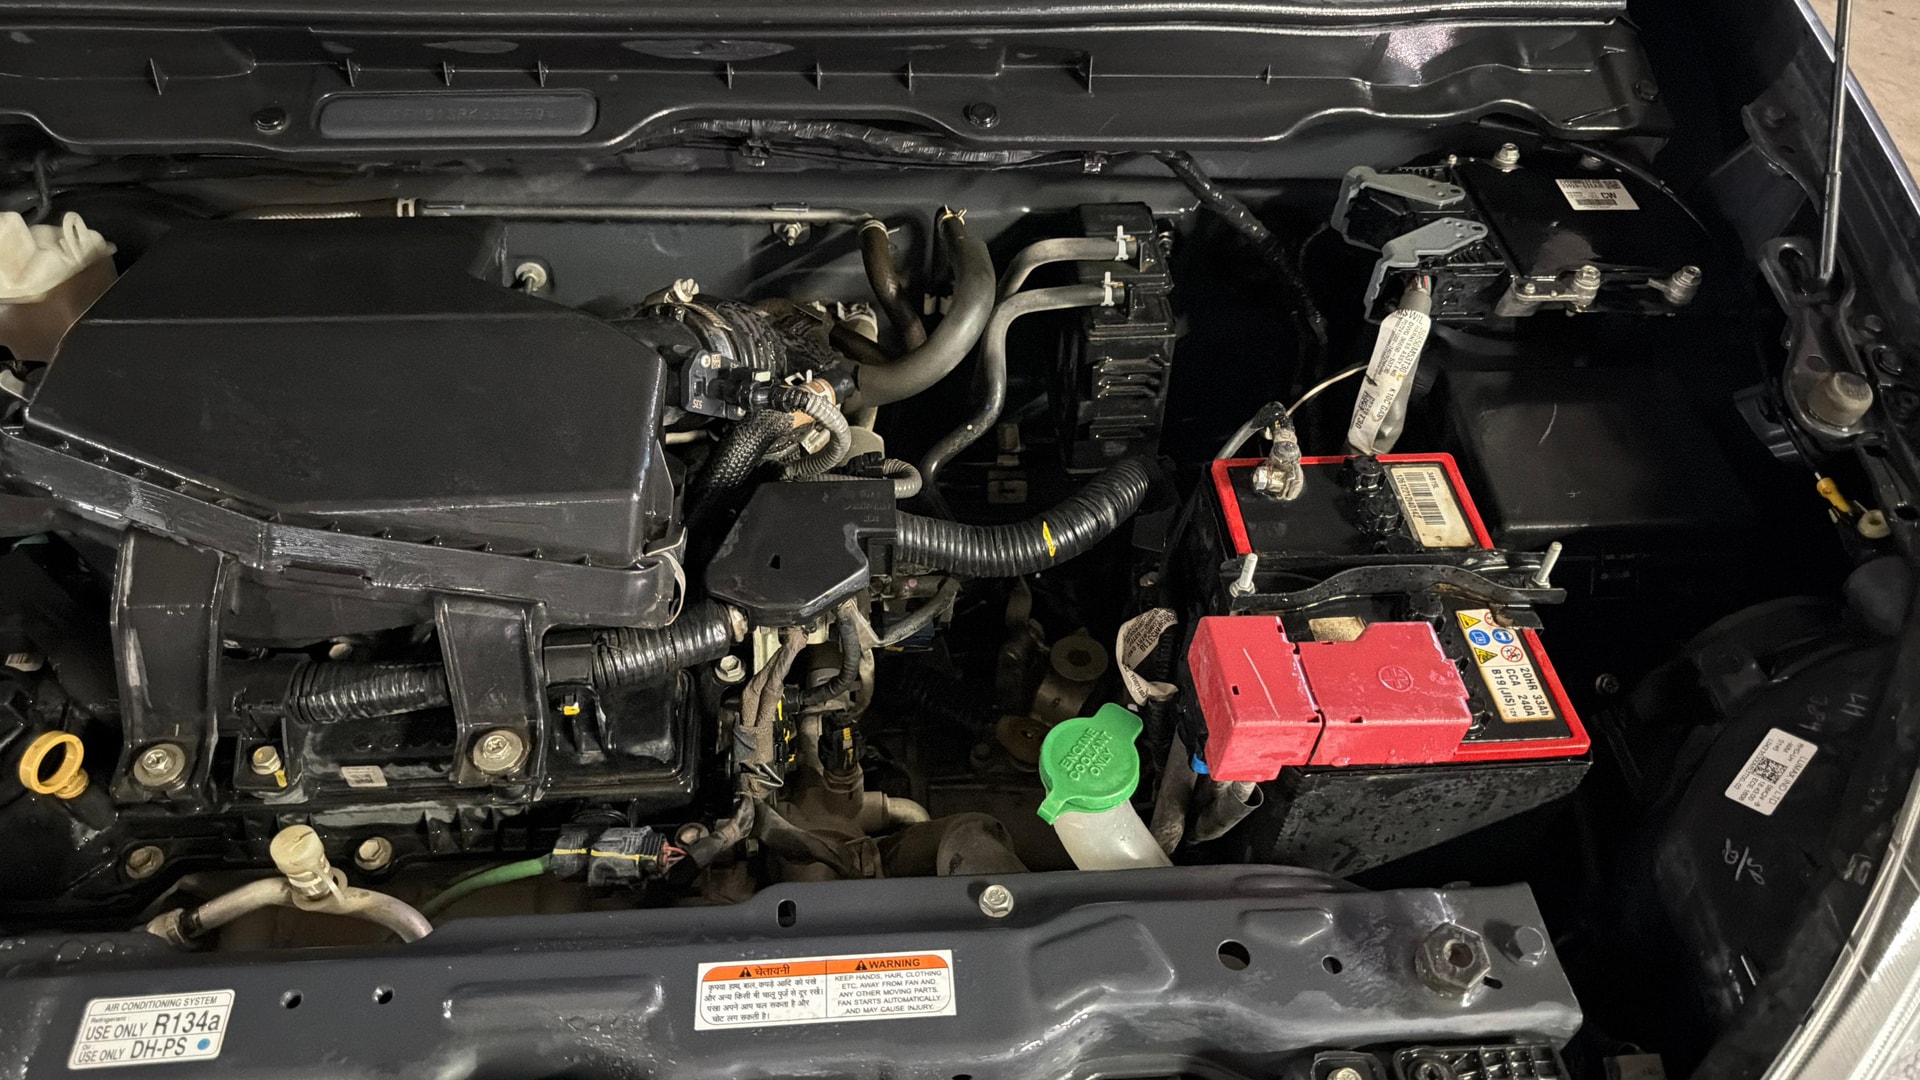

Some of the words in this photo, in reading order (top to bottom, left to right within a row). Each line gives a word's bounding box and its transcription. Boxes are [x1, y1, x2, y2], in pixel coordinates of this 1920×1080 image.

[1506, 668, 1521, 686] CCA
[1517, 694, 1536, 717] 240A
[1520, 667, 1538, 691] 20HR
[1532, 694, 1550, 717] 33Ah
[1059, 727, 1100, 772] ENGINE
[1068, 730, 1113, 781] COOLANT
[1089, 747, 1114, 777] ONLY
[1790, 755, 1808, 779] LUMAX
[869, 958, 921, 969] WARNING
[754, 964, 791, 977] चेतावनी
[884, 972, 904, 980] HAIR,
[905, 970, 942, 978] CLOTHING
[777, 978, 791, 987] आदि
[794, 977, 803, 986] को
[860, 981, 880, 989] AWAY
[704, 993, 716, 1002] और
[734, 990, 751, 1000] किसी
[883, 988, 912, 996] MOVING
[105, 1003, 119, 1012] AIR
[121, 998, 181, 1011] CONDITIONING
[183, 996, 218, 1006] SYSTEM
[769, 1001, 789, 1009] सकता
[798, 998, 809, 1007] और
[854, 998, 881, 1006] STARTS
[883, 995, 942, 1004] AUTOMATICALLY
[880, 1005, 905, 1013] CAUSE
[907, 1003, 934, 1011] INJURY.
[740, 1010, 760, 1021] सकती
[85, 1025, 112, 1041] USE
[113, 1021, 149, 1039] ONLY
[152, 1010, 221, 1036] R134a
[78, 1052, 97, 1063] USE
[99, 1047, 126, 1061] ONLY
[130, 1037, 188, 1059] DH-PS
